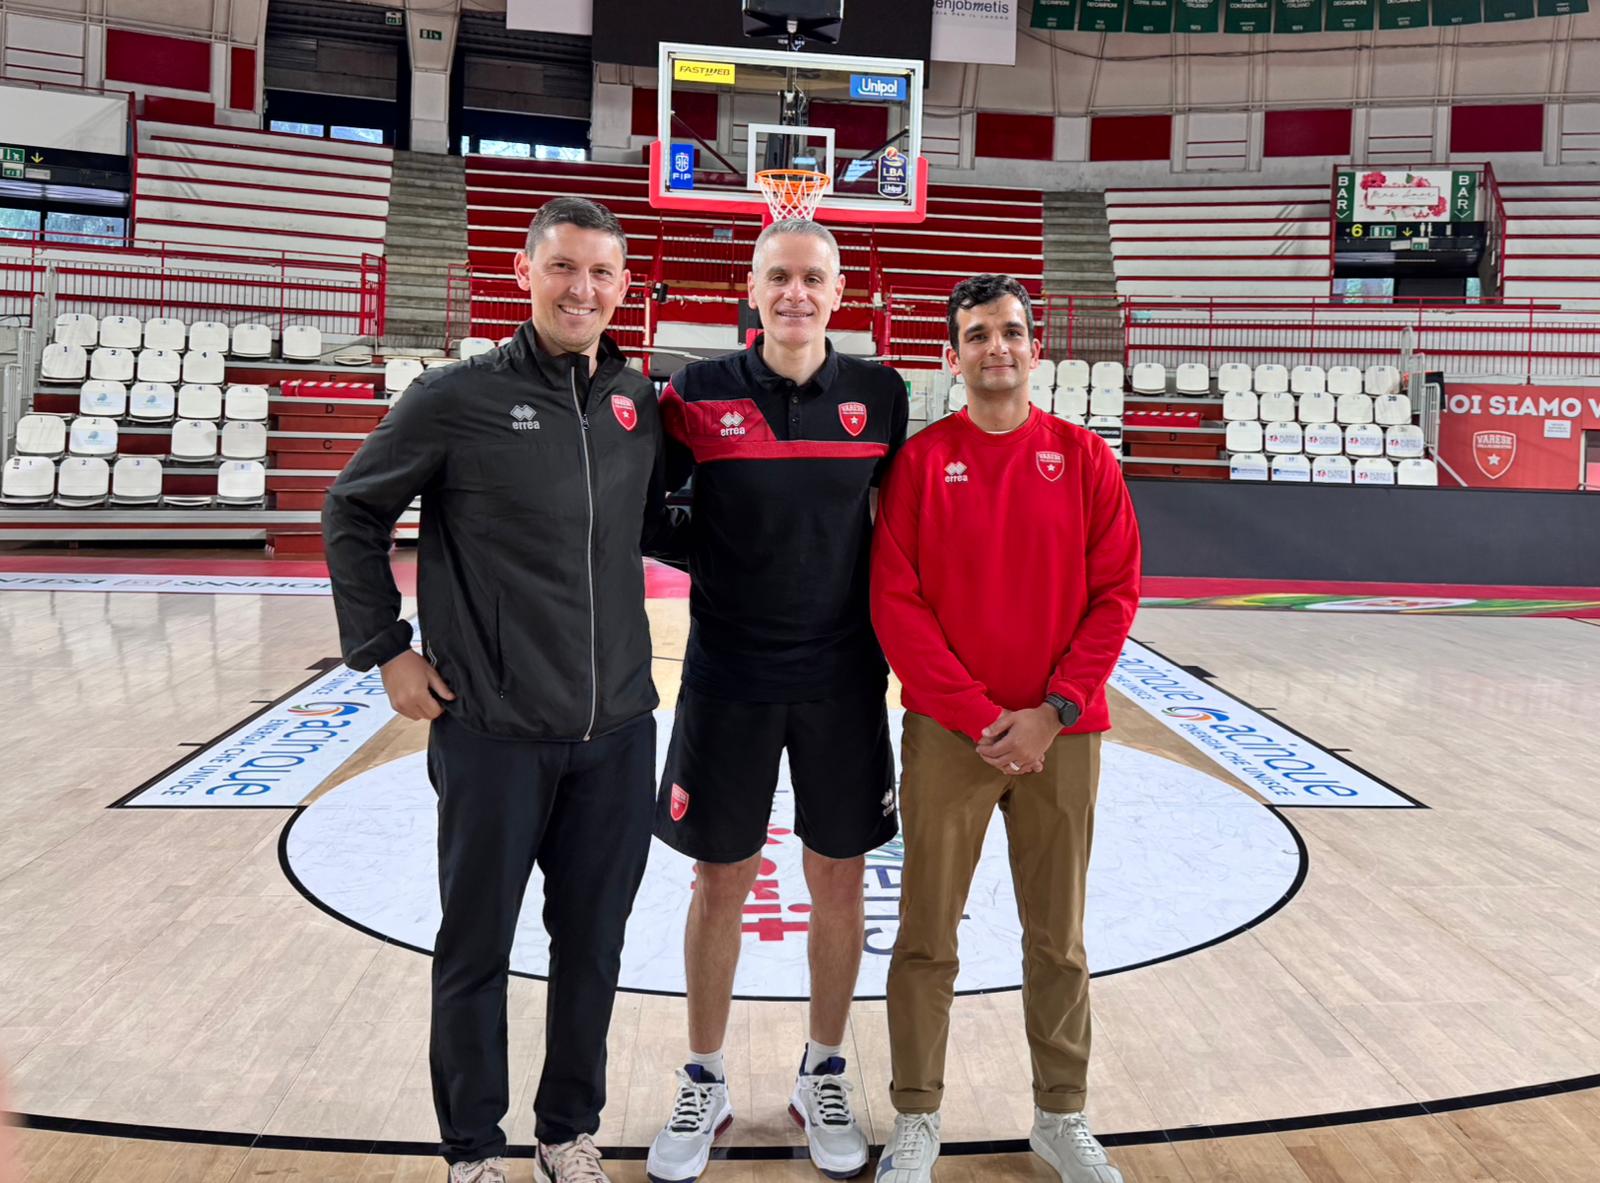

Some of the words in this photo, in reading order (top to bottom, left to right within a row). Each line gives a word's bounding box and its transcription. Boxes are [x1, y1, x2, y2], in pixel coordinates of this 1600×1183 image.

[679, 66, 730, 76] FASTWEB
[862, 78, 898, 96] Unipol
[672, 172, 692, 180] FIP
[883, 168, 904, 177] LBA
[1336, 176, 1350, 210] BAR
[1457, 175, 1470, 210] BAR
[1351, 224, 1363, 237] 6
[325, 404, 335, 414] D
[1488, 396, 1583, 418] SIAMO
[512, 420, 540, 430] errea
[720, 428, 746, 437] errea
[323, 440, 332, 450] C
[1476, 434, 1512, 445] VARESE
[240, 718, 290, 746] ENERGIA
[206, 720, 352, 796] acinque
[209, 748, 246, 763] CHE
[1178, 722, 1226, 750] ENERGIA
[1220, 750, 1248, 766] CHE
[1237, 765, 1296, 797] UNISCE
[1208, 724, 1358, 798] acinque
[161, 766, 218, 796] UNISCE
